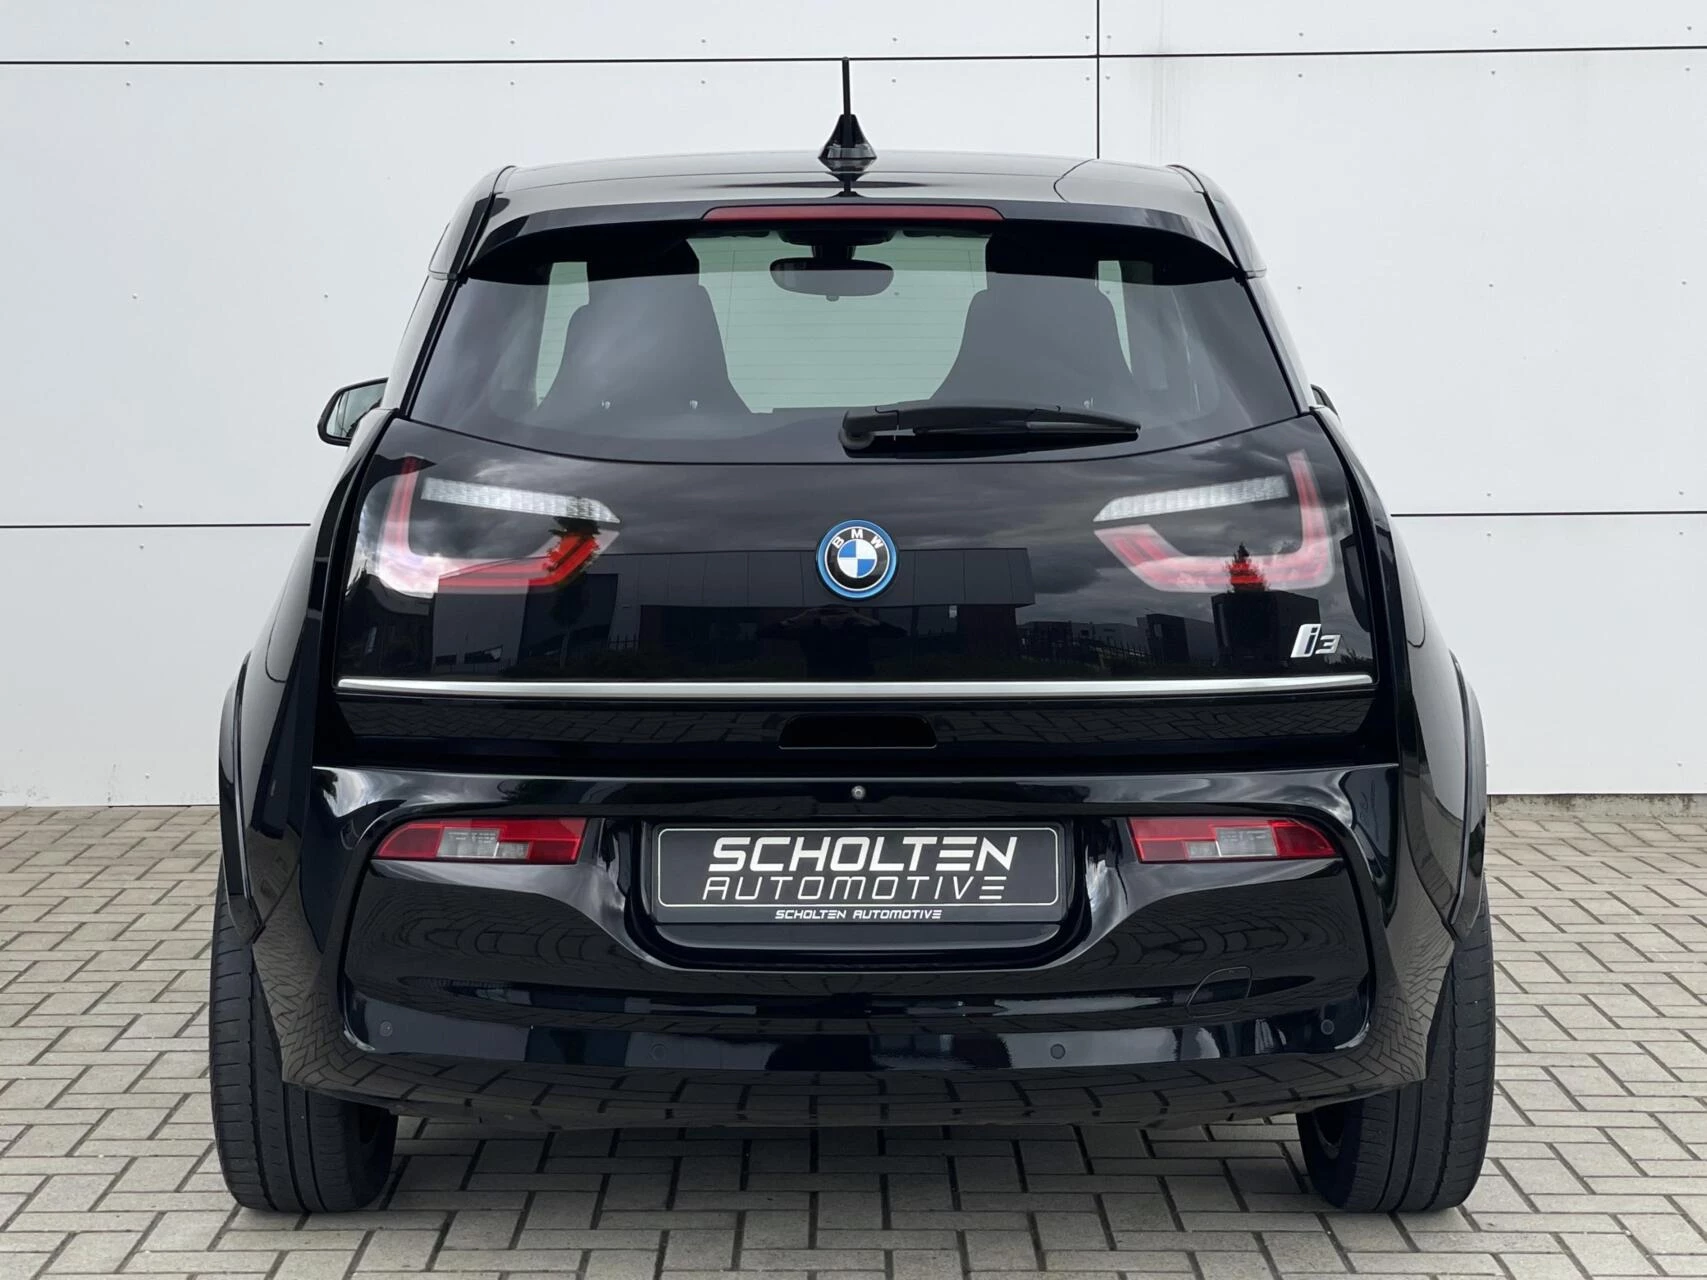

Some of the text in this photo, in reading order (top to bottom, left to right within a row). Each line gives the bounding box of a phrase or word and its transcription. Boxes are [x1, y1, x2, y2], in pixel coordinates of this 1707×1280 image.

[832, 528, 884, 549] BMW
[1290, 623, 1341, 658] i3
[708, 836, 1017, 872] SCHOLTEN
[702, 876, 1007, 901] AUTOMOTIVE
[774, 909, 942, 920] SCHOLTEN AUTOMOTIVE
